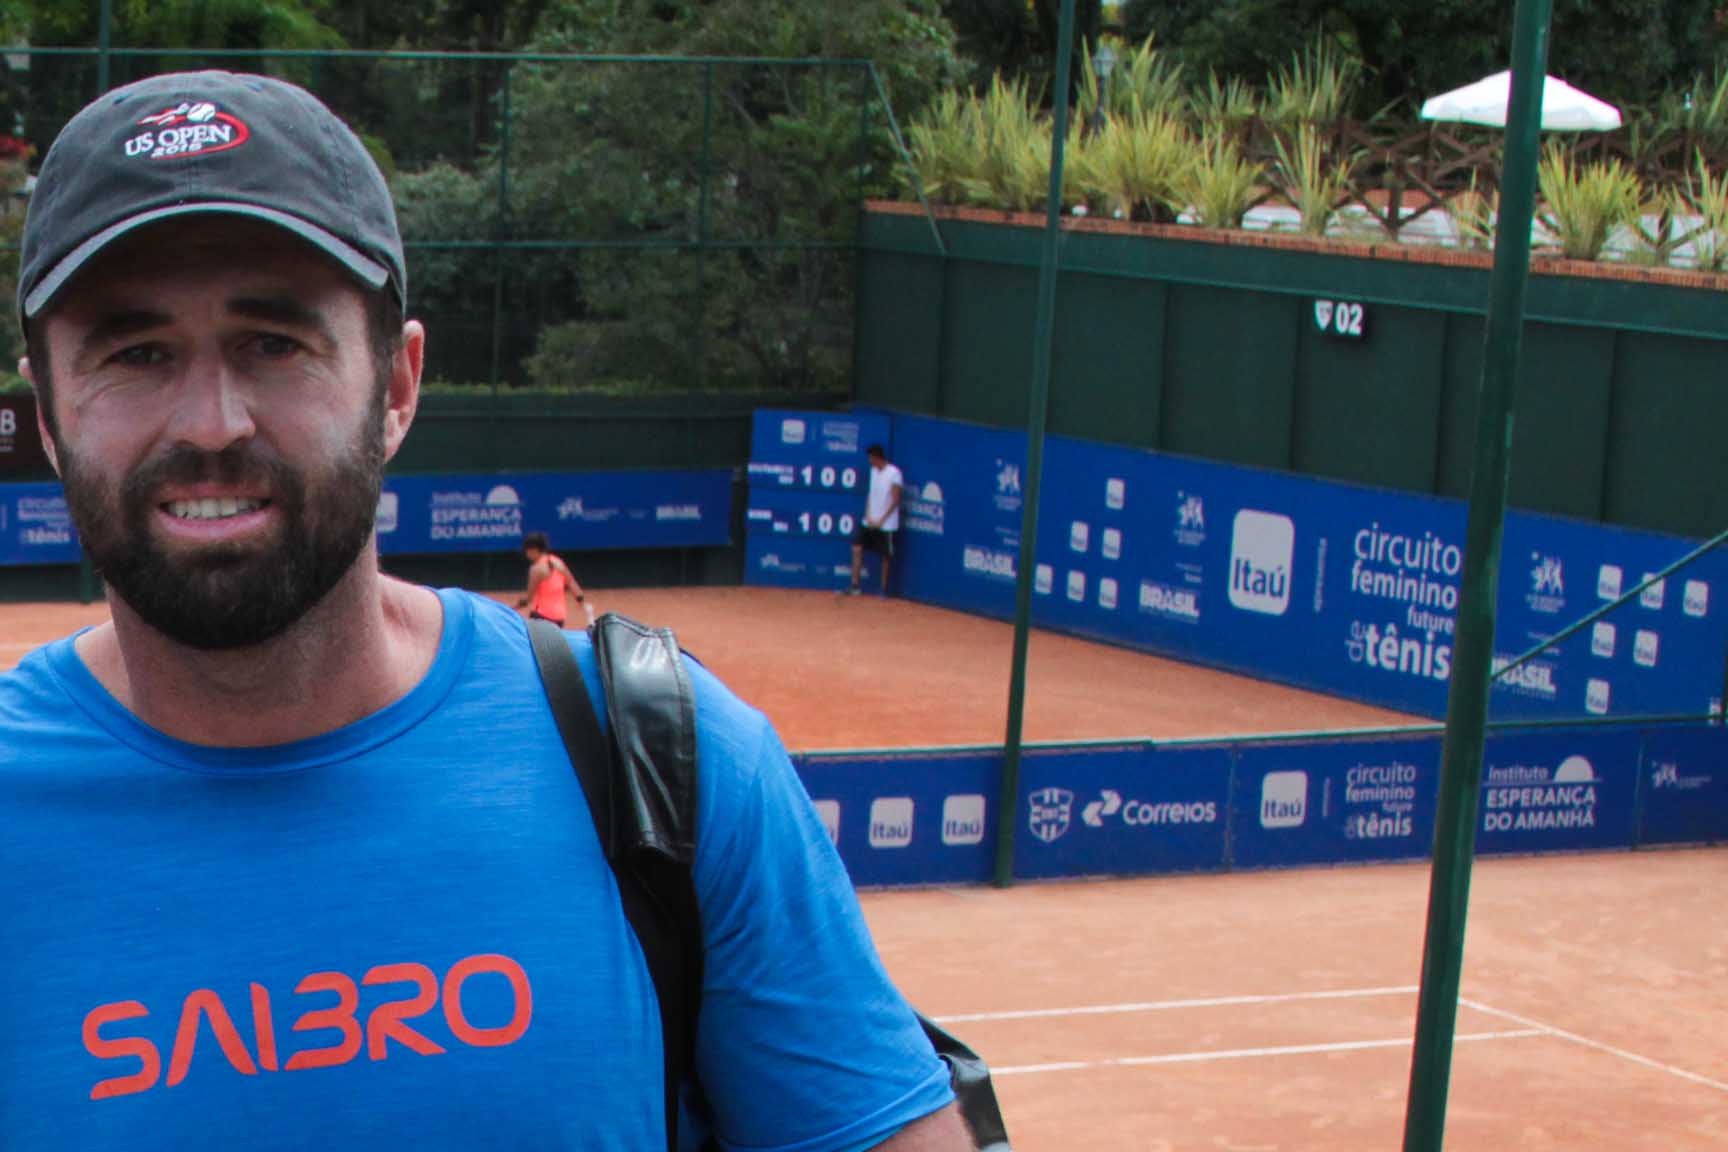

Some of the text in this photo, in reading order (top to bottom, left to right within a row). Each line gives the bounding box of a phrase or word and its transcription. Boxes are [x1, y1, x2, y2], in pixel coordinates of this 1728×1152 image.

[125, 124, 232, 156] US OPEN
[1335, 302, 1364, 336] 02
[431, 505, 521, 524] ESPERANÇA
[431, 525, 454, 540] DO
[1354, 522, 1461, 576] circuito
[1233, 559, 1286, 599] Itaú
[1351, 559, 1458, 610] feminino
[1407, 604, 1455, 635] future
[1365, 621, 1451, 681] tênis
[1346, 761, 1416, 785] circuito
[1488, 764, 1548, 782] Instituto
[1345, 783, 1416, 803] feminino
[1484, 786, 1596, 809] ESPERANÇA
[1122, 800, 1216, 824] Correios
[1265, 799, 1302, 819] Itaú
[1484, 804, 1595, 832] DO AMANHÃ
[872, 821, 910, 839] Itaú
[944, 819, 980, 836] Itaú
[1357, 812, 1412, 838] tênis
